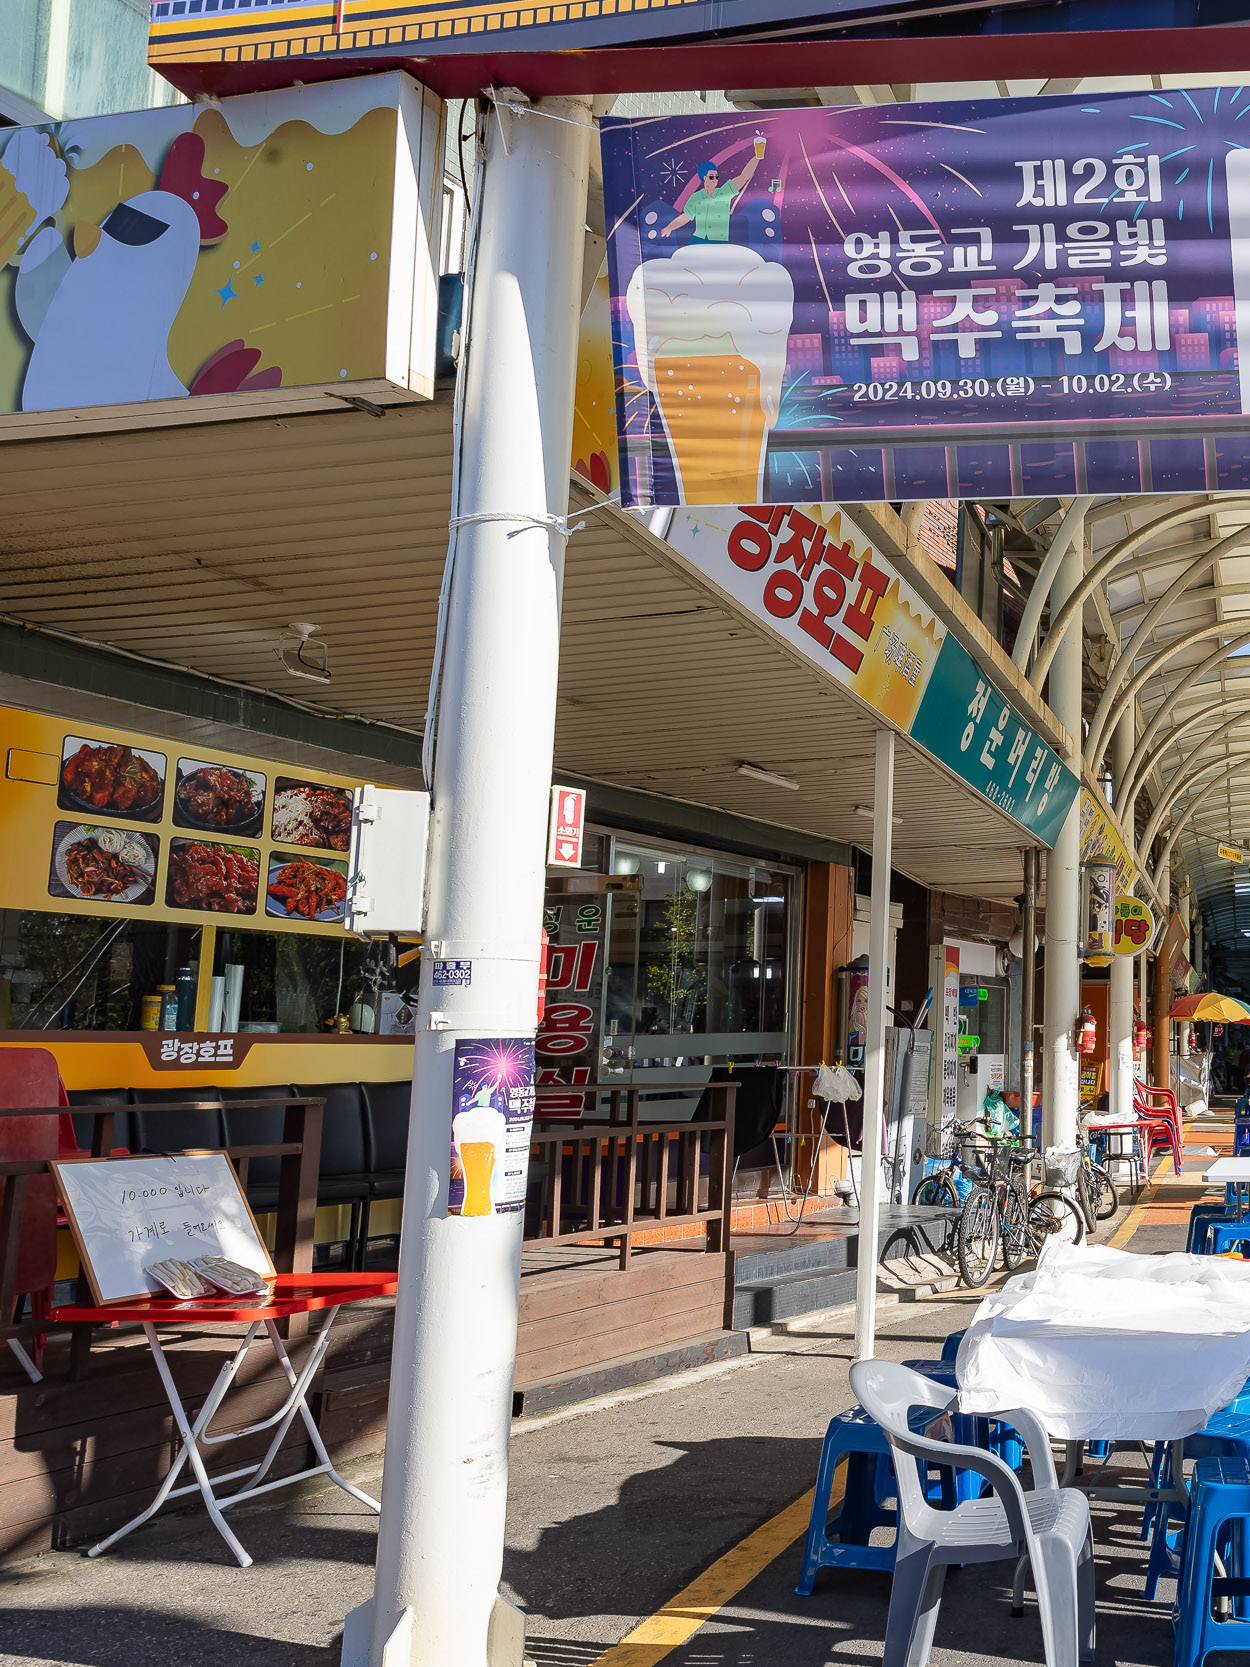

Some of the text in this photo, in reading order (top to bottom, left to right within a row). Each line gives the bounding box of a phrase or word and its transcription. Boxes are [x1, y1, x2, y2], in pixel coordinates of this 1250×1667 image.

[1014, 154, 1162, 208] 제2회
[844, 218, 1168, 279] 영동교 가을빛
[844, 280, 1171, 361] 맥주축제
[852, 377, 1035, 401] 2024.09.30.(월)
[1059, 372, 1172, 394] 10.02.(수)
[961, 679, 1062, 816] 정운머리방
[557, 826, 579, 837] 소화기
[434, 970, 470, 979] 462-0302
[160, 1039, 234, 1063] 광장호프
[174, 1184, 210, 1198] 입니다
